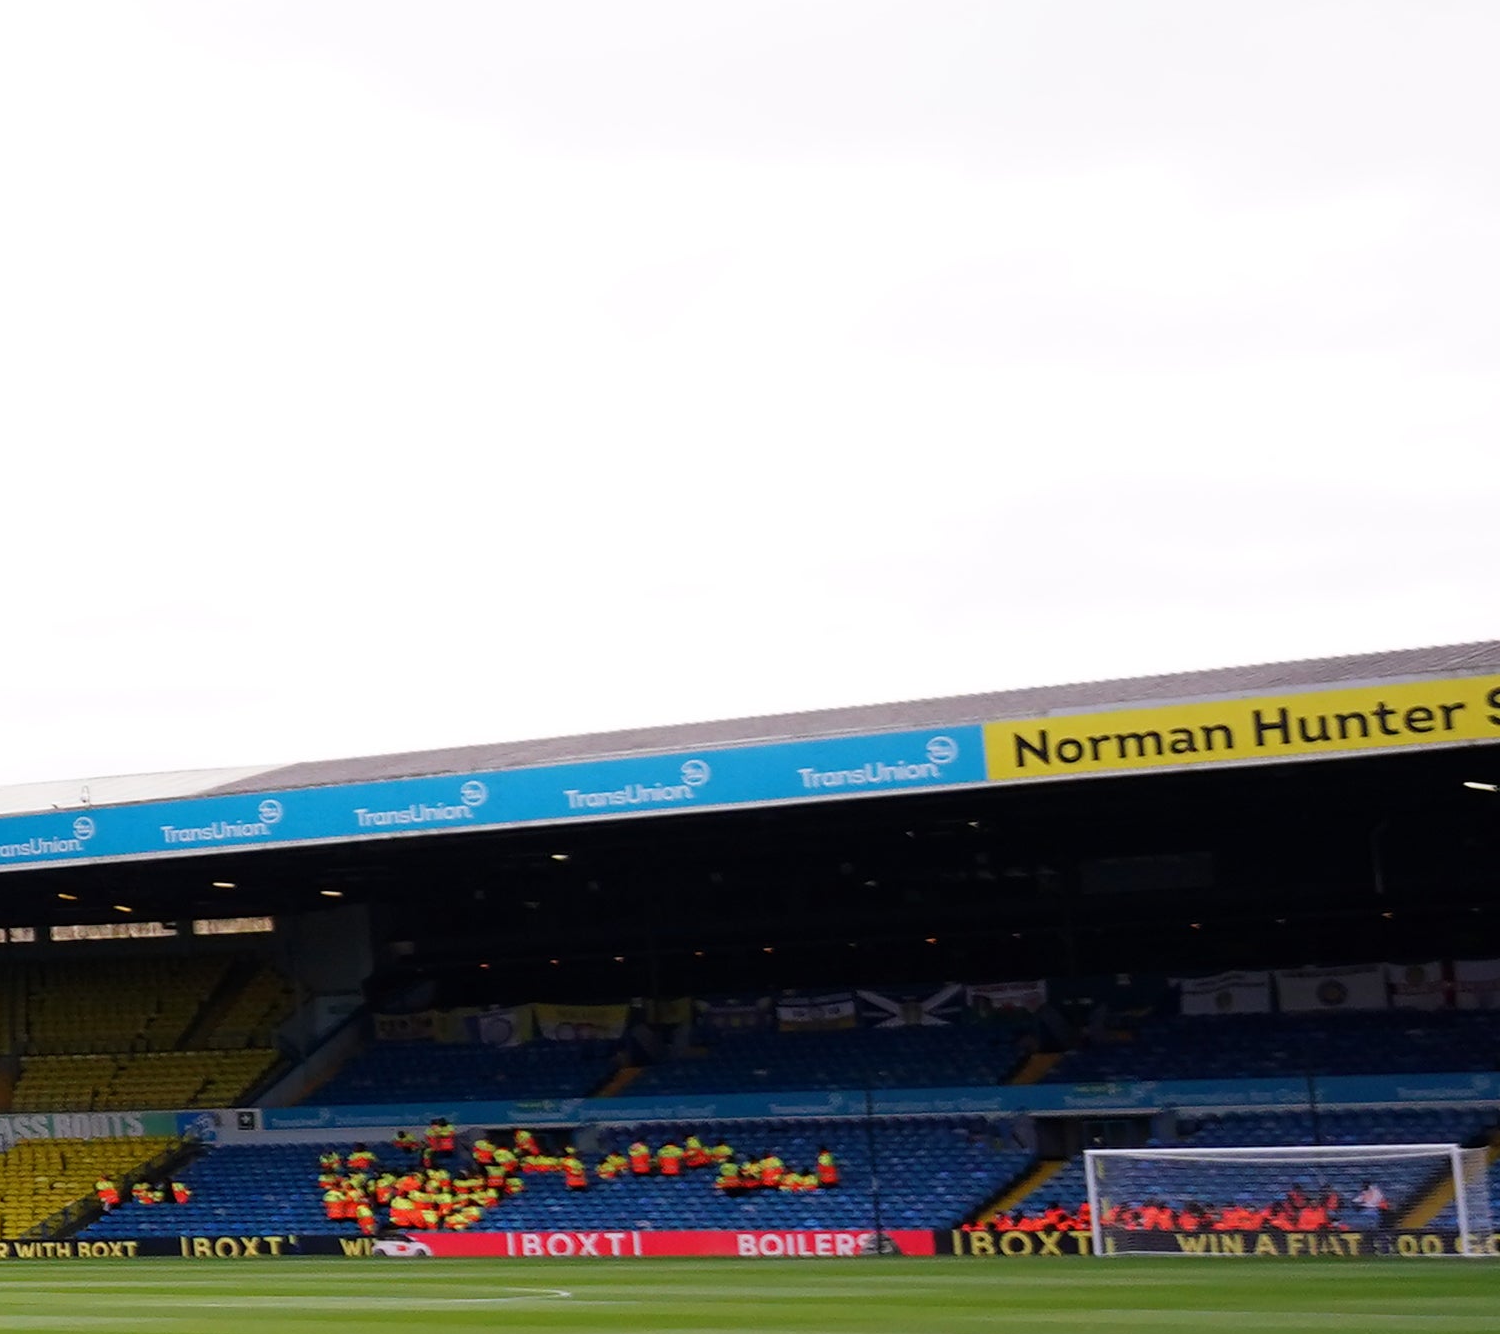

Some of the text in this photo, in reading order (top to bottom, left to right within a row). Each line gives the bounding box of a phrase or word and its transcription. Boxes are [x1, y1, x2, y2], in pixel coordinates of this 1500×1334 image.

[1014, 722, 1233, 768] Norman
[1253, 701, 1465, 747] Hunter
[797, 761, 938, 788] TransUnion
[564, 784, 695, 809] TransUnion
[354, 803, 474, 827] TransUnion
[161, 821, 271, 843] TransUnion
[13, 1241, 70, 1259] WITH
[77, 1241, 137, 1258] BOXT
[194, 1236, 280, 1256] BOXT
[523, 1233, 624, 1256] BOXT
[972, 1231, 1092, 1256] BOXT
[1176, 1233, 1247, 1256] WIN
[1255, 1233, 1277, 1256] A
[1289, 1233, 1360, 1256] FIAT
